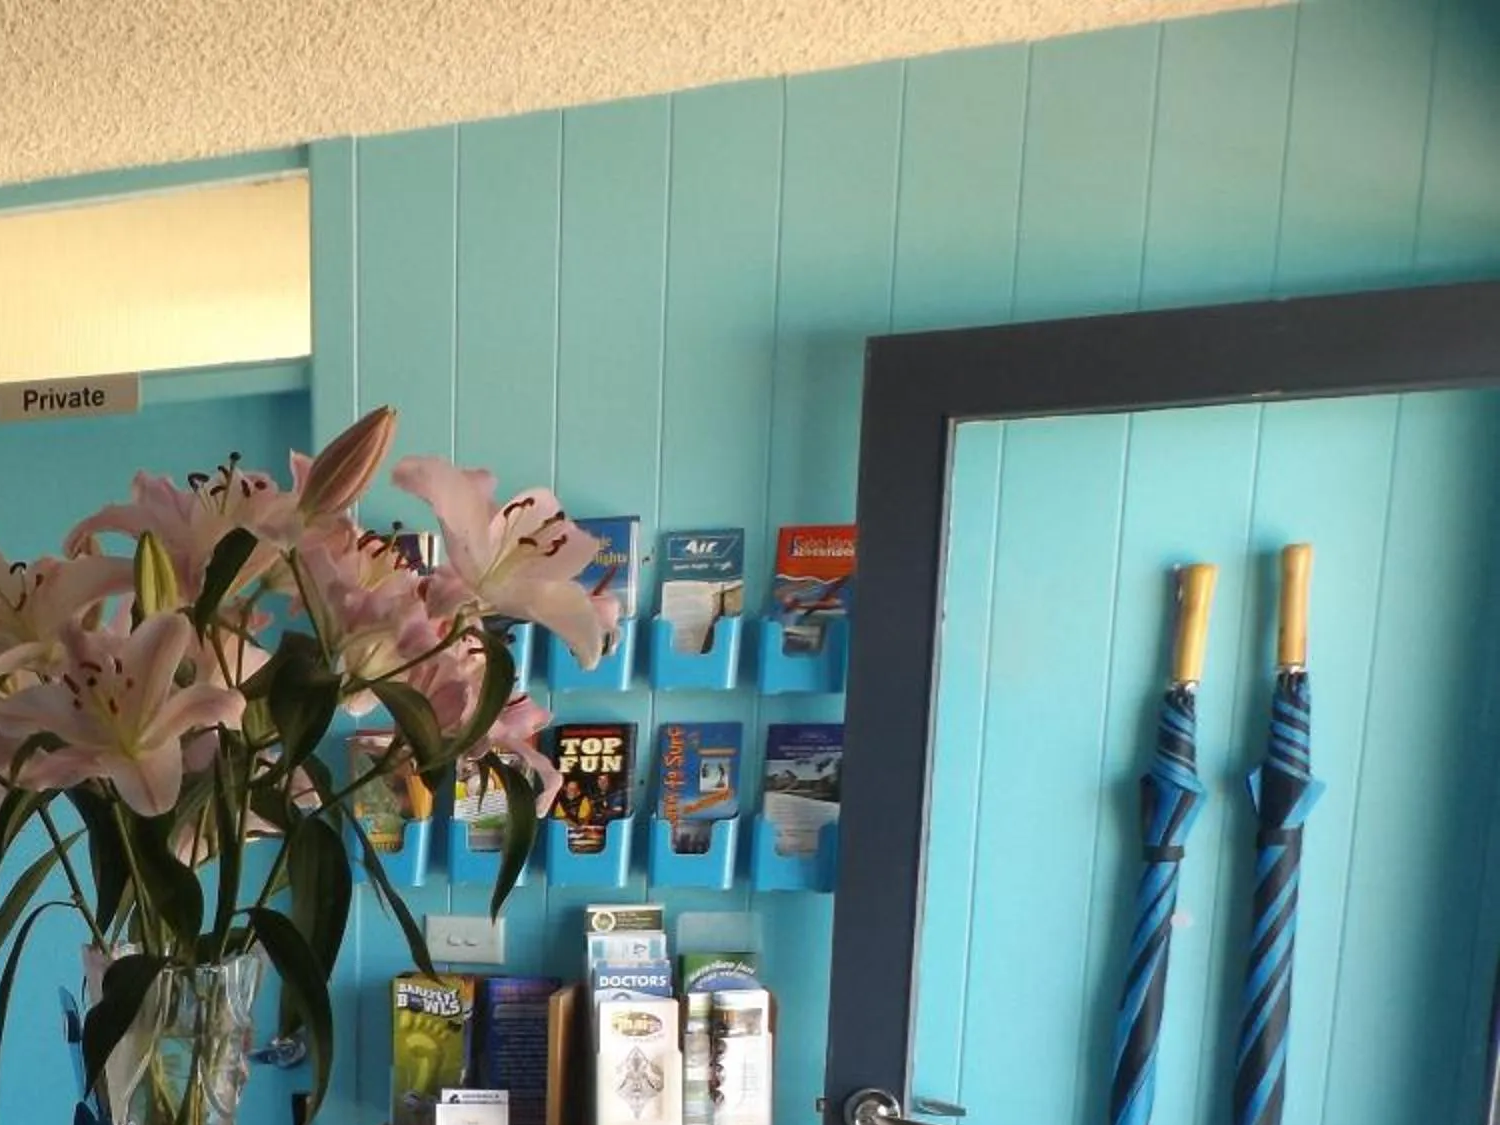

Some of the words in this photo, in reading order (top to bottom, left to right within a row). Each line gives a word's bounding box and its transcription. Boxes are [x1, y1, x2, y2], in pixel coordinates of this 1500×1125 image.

[22, 387, 105, 412] Private
[560, 736, 623, 756] TOP
[558, 755, 623, 774] FUN
[599, 975, 667, 988] DOCTORS
